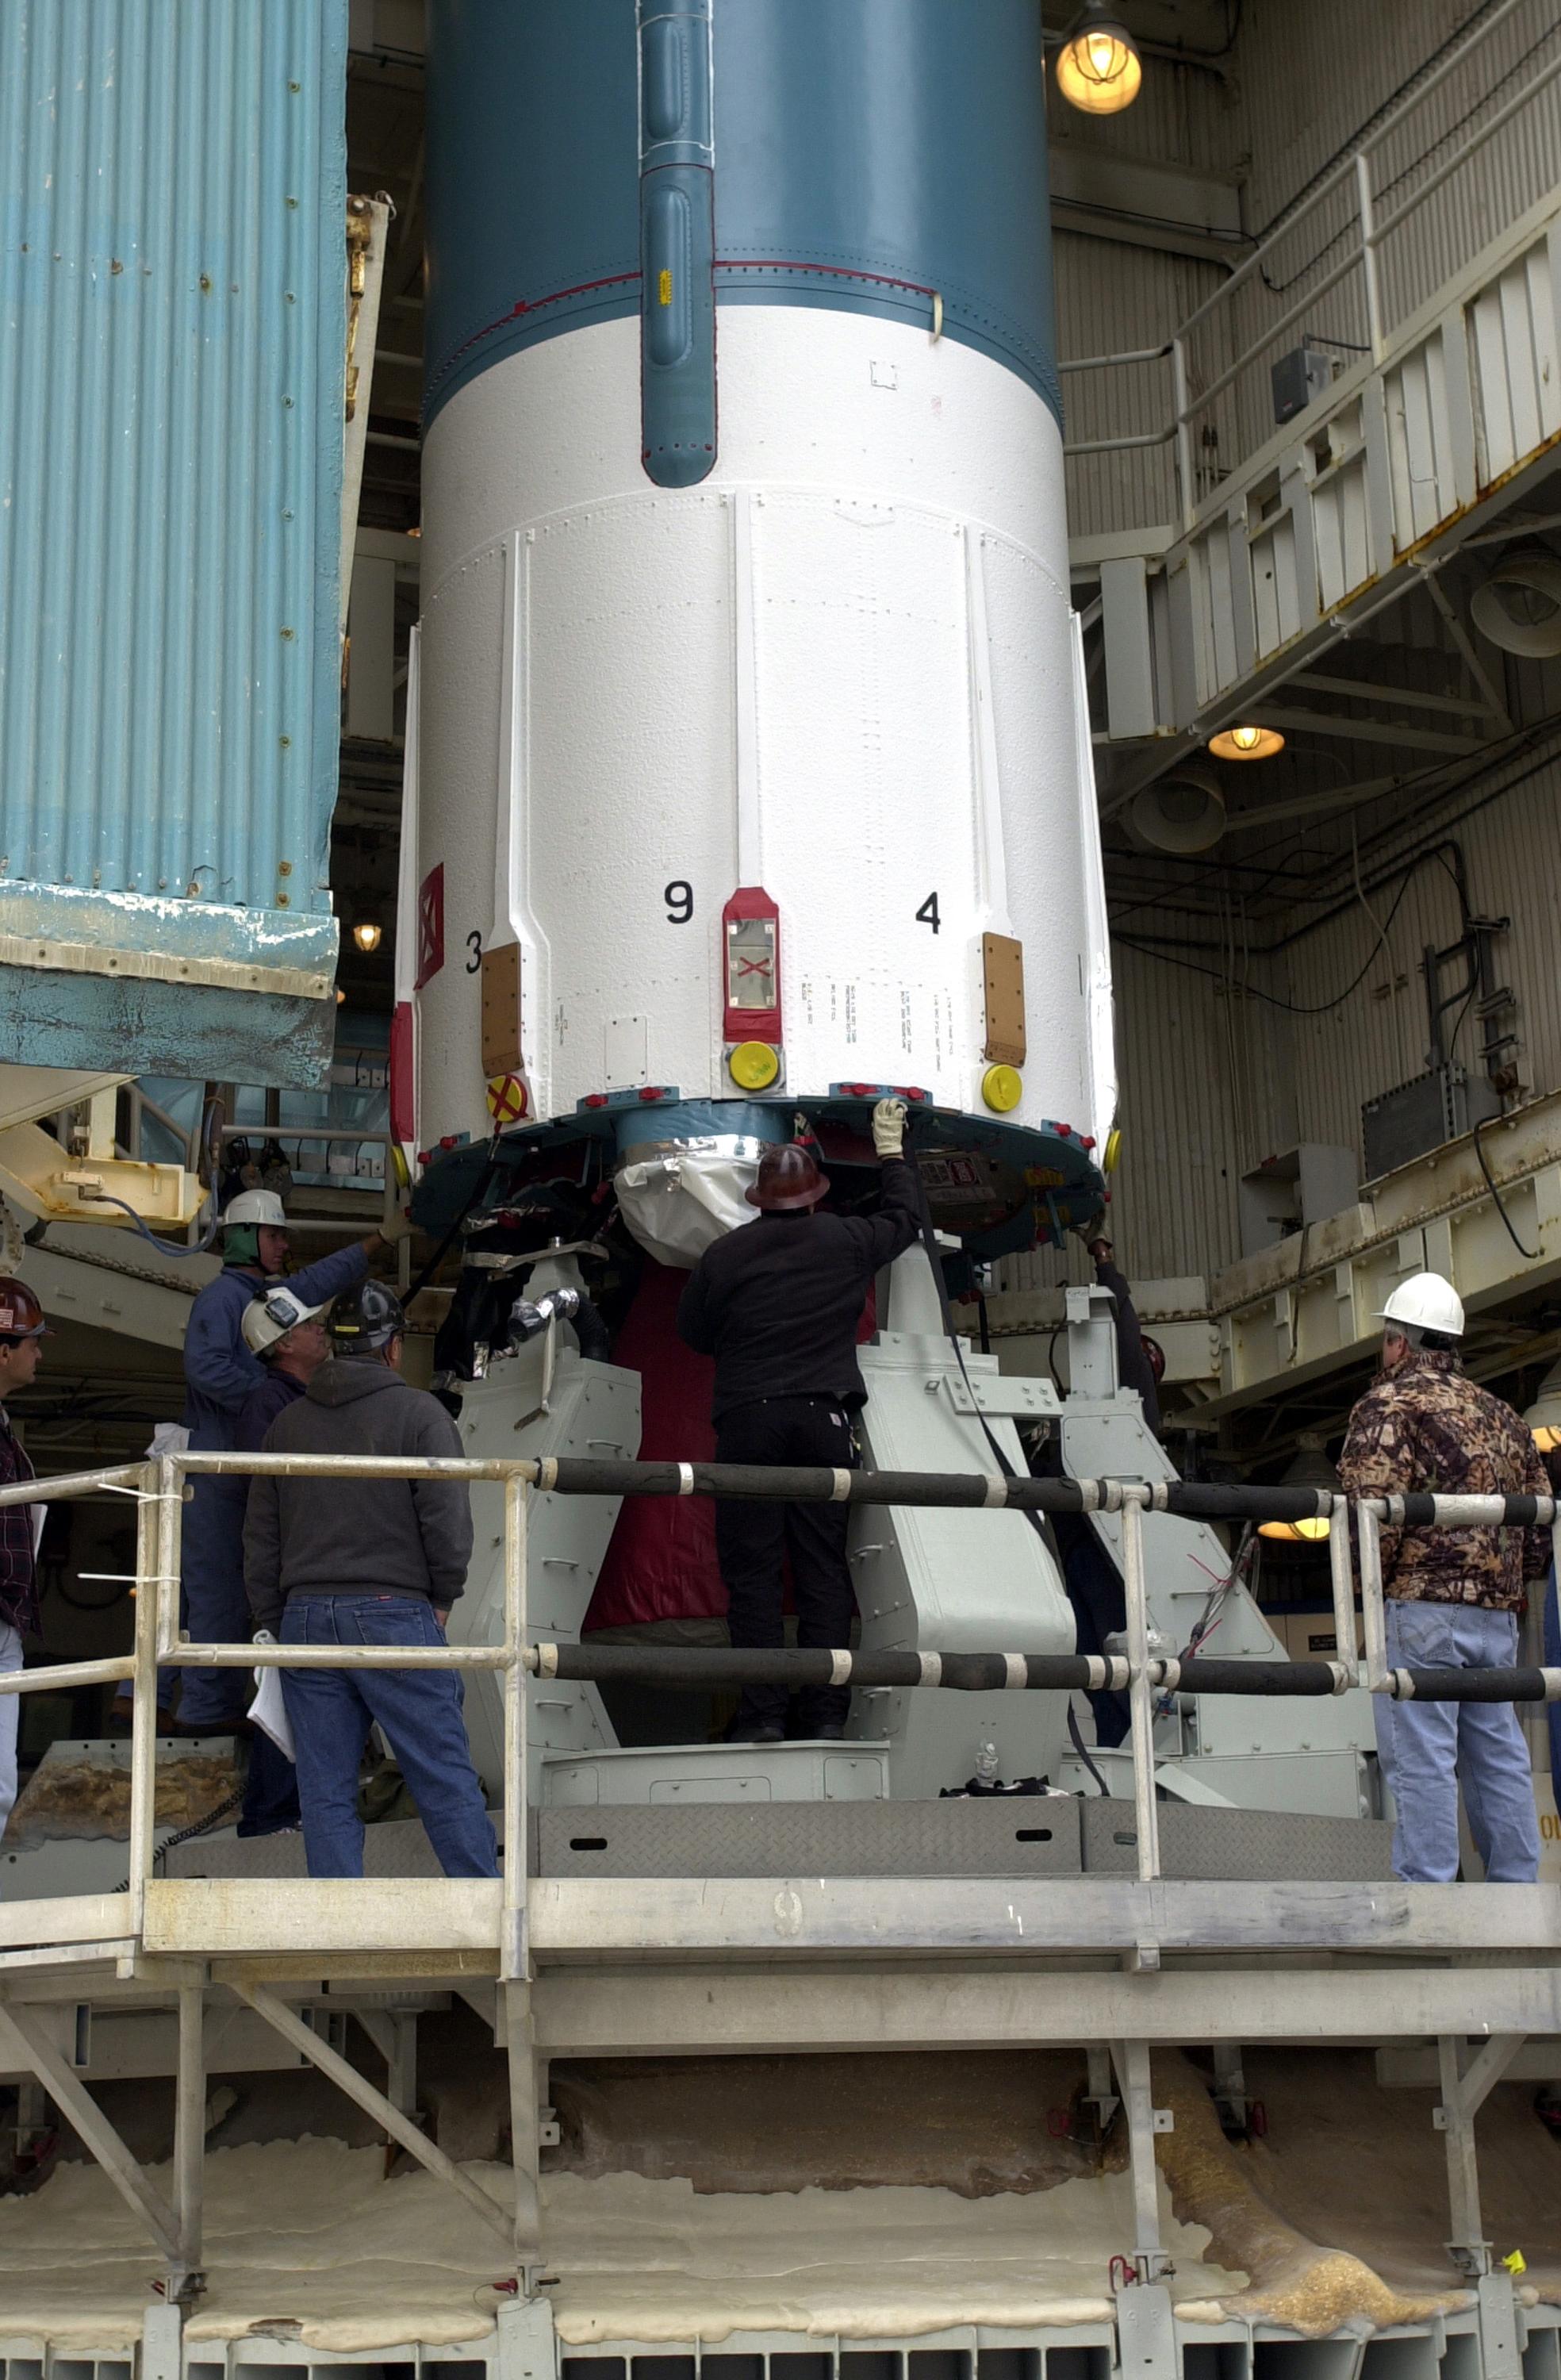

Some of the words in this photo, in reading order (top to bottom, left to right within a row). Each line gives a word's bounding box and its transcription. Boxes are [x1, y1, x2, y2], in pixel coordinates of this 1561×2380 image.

[665, 881, 693, 923] 9
[915, 891, 941, 935] 4
[466, 931, 481, 973] 3
